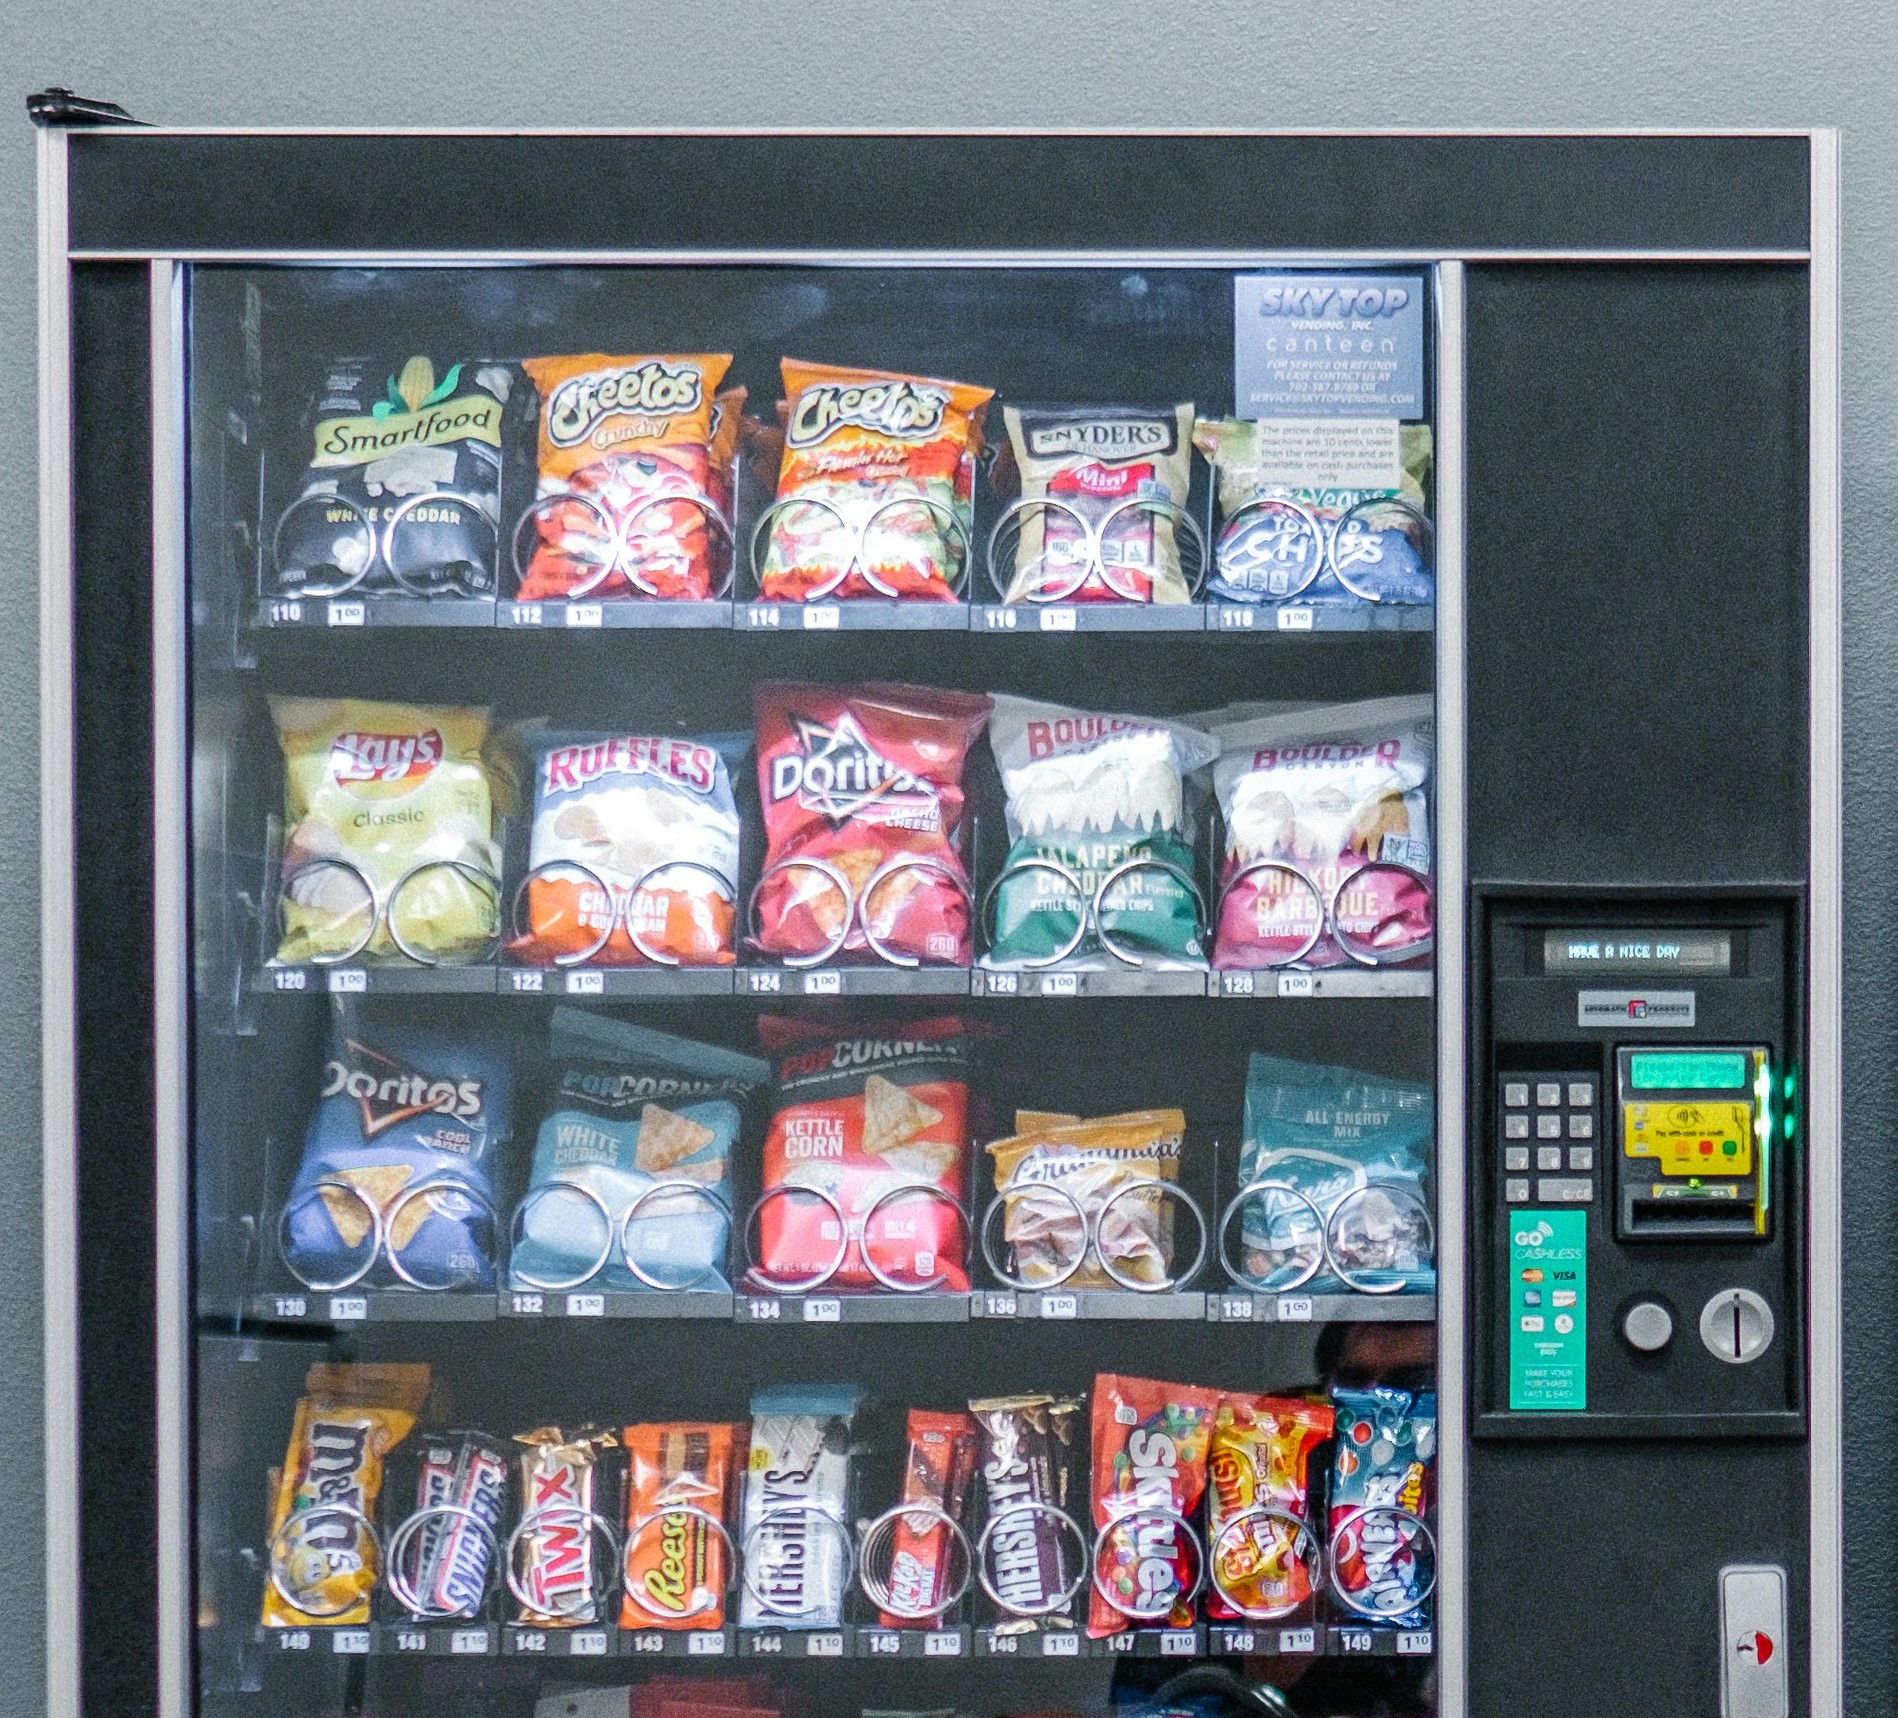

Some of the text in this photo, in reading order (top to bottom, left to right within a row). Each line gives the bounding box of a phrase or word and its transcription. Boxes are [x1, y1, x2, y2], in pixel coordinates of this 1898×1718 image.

[1265, 336, 1395, 354] canteen
[1289, 360, 1331, 370] SERVICE
[1350, 360, 1398, 370] REFUNDS
[1274, 371, 1312, 381] PLEASE
[1314, 371, 1361, 381] CONTACT
[551, 363, 701, 445] Cheetos
[788, 382, 942, 446] Cheetos
[325, 409, 491, 454] Smartfood
[593, 417, 669, 448] Crunchy
[1039, 424, 1163, 445] SNYDER'S
[1263, 425, 1394, 437] The prices displayed on this
[1262, 437, 1302, 446] machine
[1338, 438, 1363, 447] cents
[1366, 438, 1393, 447] lower
[1261, 449, 1283, 458] than
[1286, 449, 1302, 458] the
[1304, 449, 1329, 458] retail
[1332, 449, 1356, 460] price
[1358, 449, 1376, 458] and
[1261, 460, 1303, 469] available
[1321, 460, 1344, 469] cash
[1346, 460, 1394, 472] purchases
[1317, 472, 1338, 483] only
[383, 507, 461, 525] CEDDAR
[1246, 530, 1384, 564] CHPS
[270, 602, 301, 622] 110
[512, 607, 543, 624] 112
[749, 608, 780, 626] 114
[986, 609, 1017, 628] 116
[1223, 609, 1254, 627] 118
[548, 735, 713, 790] RUFFLES
[772, 750, 938, 801] Doritos
[353, 808, 425, 829] Classic
[889, 806, 940, 821] NACHO
[885, 817, 940, 834] CHEESE
[1256, 891, 1380, 922] BARBQUE
[1568, 945, 1680, 959] HAVE A NICE DAY
[275, 971, 306, 990] 120
[513, 973, 543, 991] 122
[750, 973, 781, 992] 124
[987, 975, 1018, 993] 126
[1223, 975, 1254, 994] 128
[321, 1060, 482, 1115] Doritos
[1550, 1093, 1558, 1105] 2
[1304, 1109, 1389, 1127] ALL ENERGY
[784, 1118, 845, 1138] KETTLE
[1333, 1125, 1361, 1139] MIX
[556, 1124, 621, 1153] WHITE
[554, 1146, 618, 1167] CHEDDAR
[784, 1136, 844, 1160] CORN
[1518, 1157, 1526, 1168] 7
[1514, 1231, 1544, 1247] GO
[1514, 1247, 1583, 1260] CASHLESS
[1553, 1271, 1577, 1280] VISA
[276, 1298, 307, 1317] 130
[512, 1295, 543, 1313] 132
[750, 1300, 781, 1319] 134
[987, 1297, 1017, 1315] 136
[1223, 1300, 1253, 1319] 138
[447, 1466, 508, 1616] SNICKERS
[533, 1465, 585, 1606] TWIX
[985, 1460, 1044, 1606] HERSHEY'S
[397, 1632, 427, 1650] 141
[515, 1634, 547, 1651] 142
[634, 1634, 664, 1652] 143
[752, 1635, 783, 1653] 144
[870, 1635, 900, 1653] 145
[988, 1635, 1018, 1653] 146
[1106, 1633, 1135, 1651] 147
[1224, 1633, 1255, 1651] 148
[1341, 1634, 1372, 1651] 149
